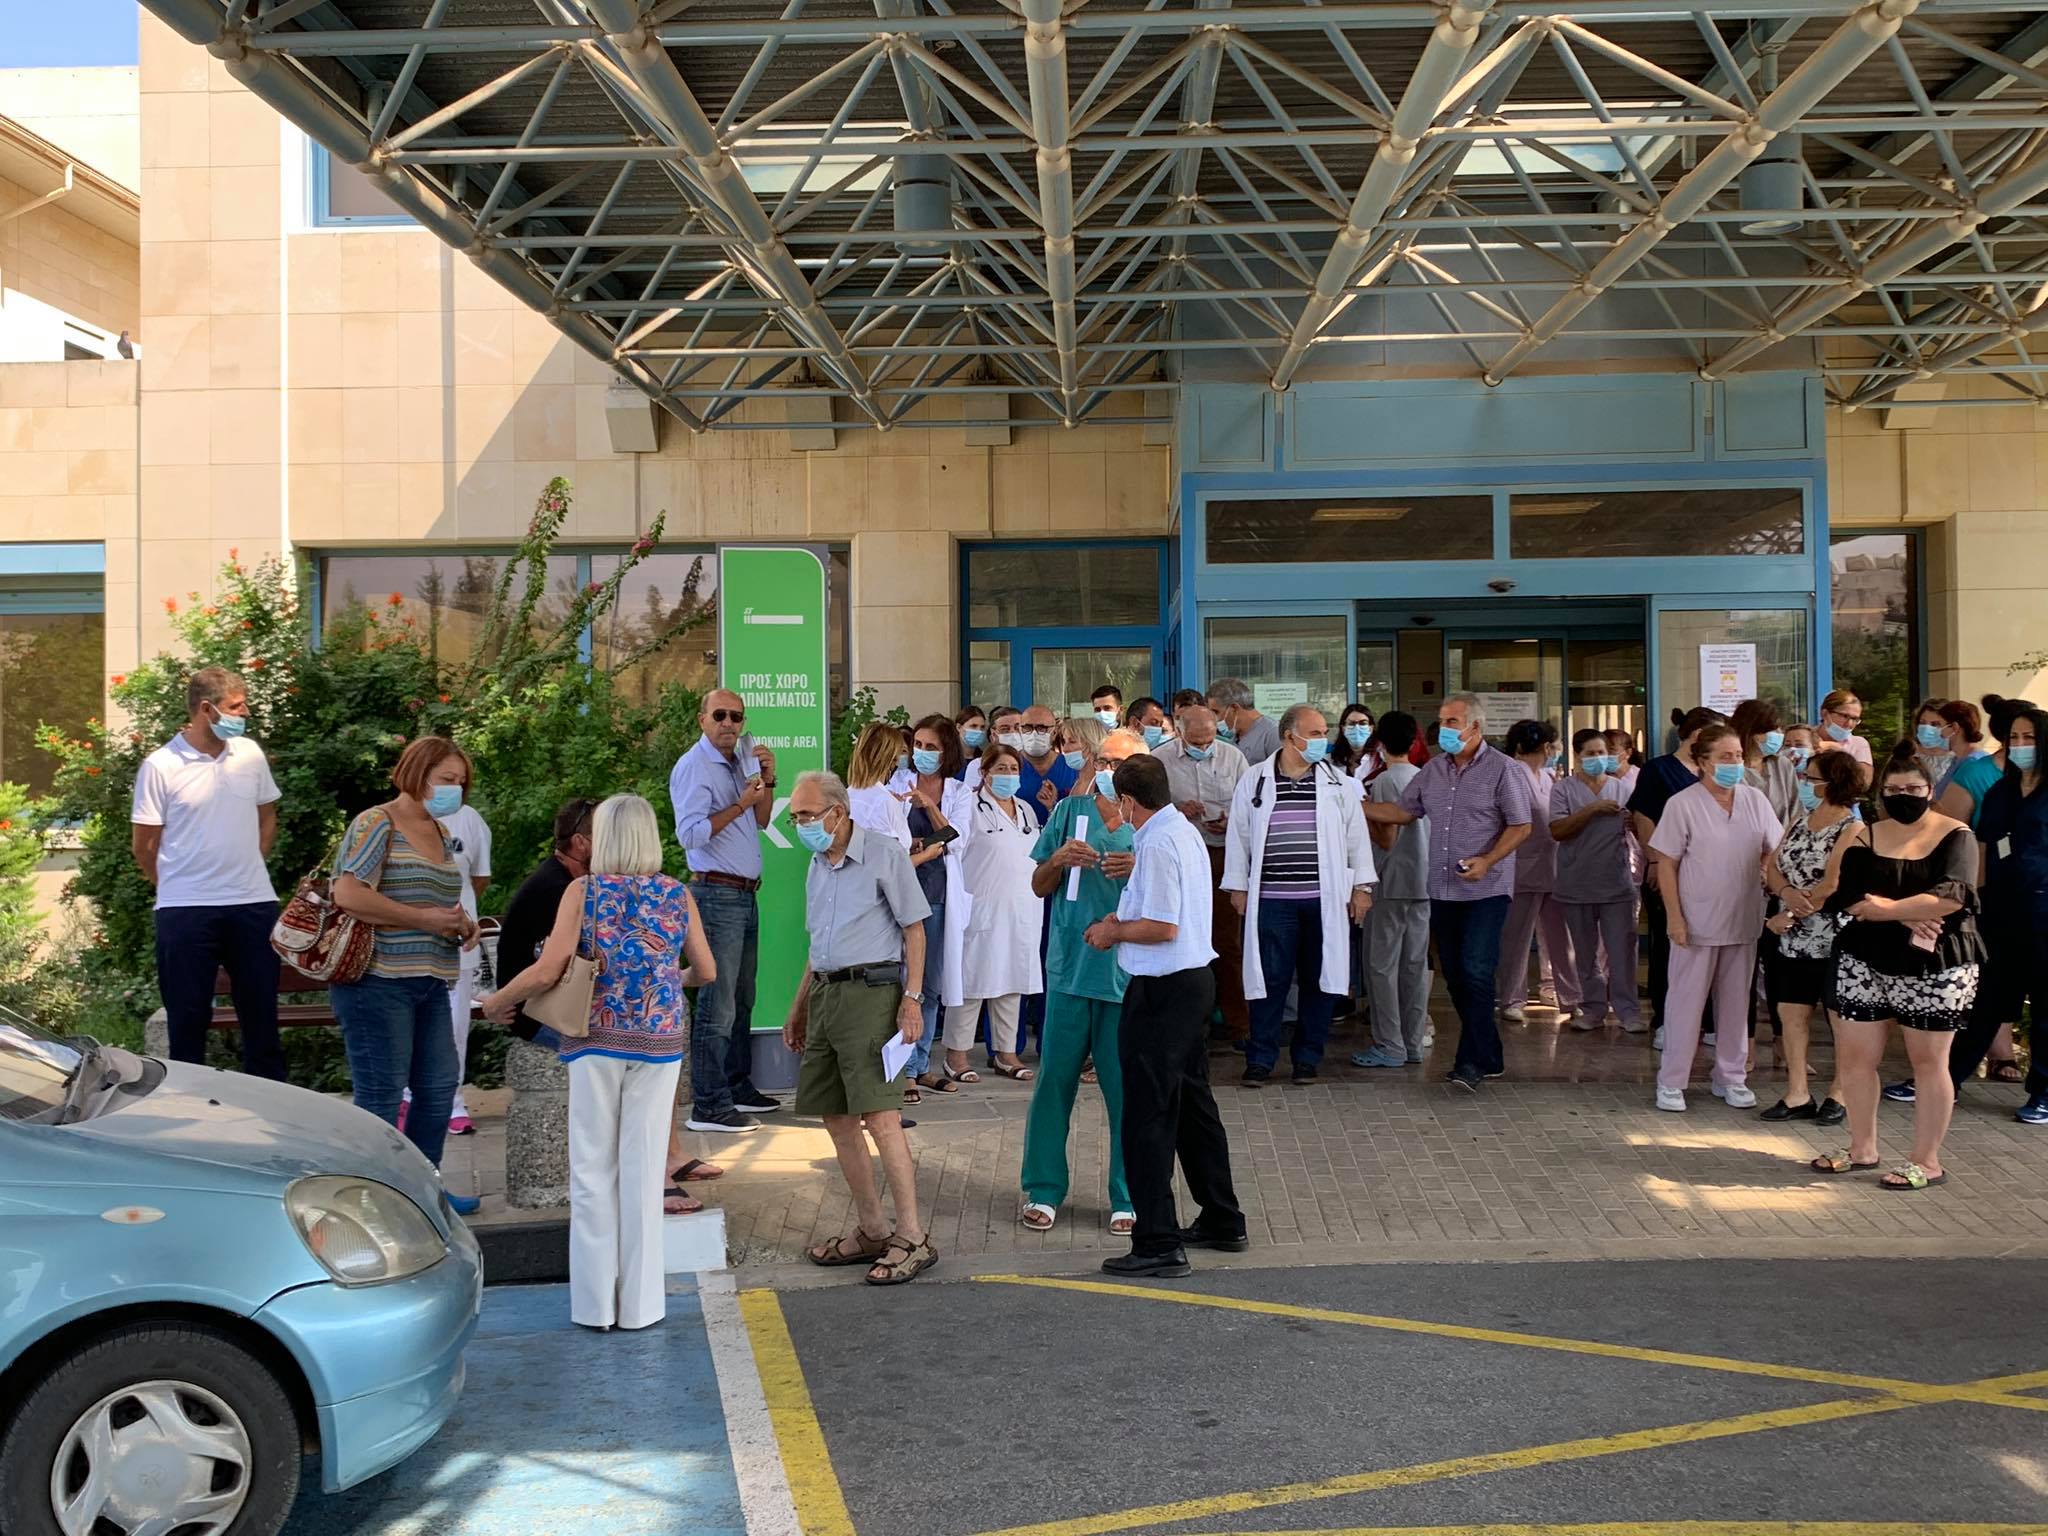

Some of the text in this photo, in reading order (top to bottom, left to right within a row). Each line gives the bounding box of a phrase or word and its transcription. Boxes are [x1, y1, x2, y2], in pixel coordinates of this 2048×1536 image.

[740, 673, 808, 689] ΠΡΟΣ ΧΩΡΟ
[736, 692, 817, 708] ΑΠΝΙΣΜΑΤΟΣ
[752, 735, 791, 748] MOKING
[793, 735, 817, 748] AREA
